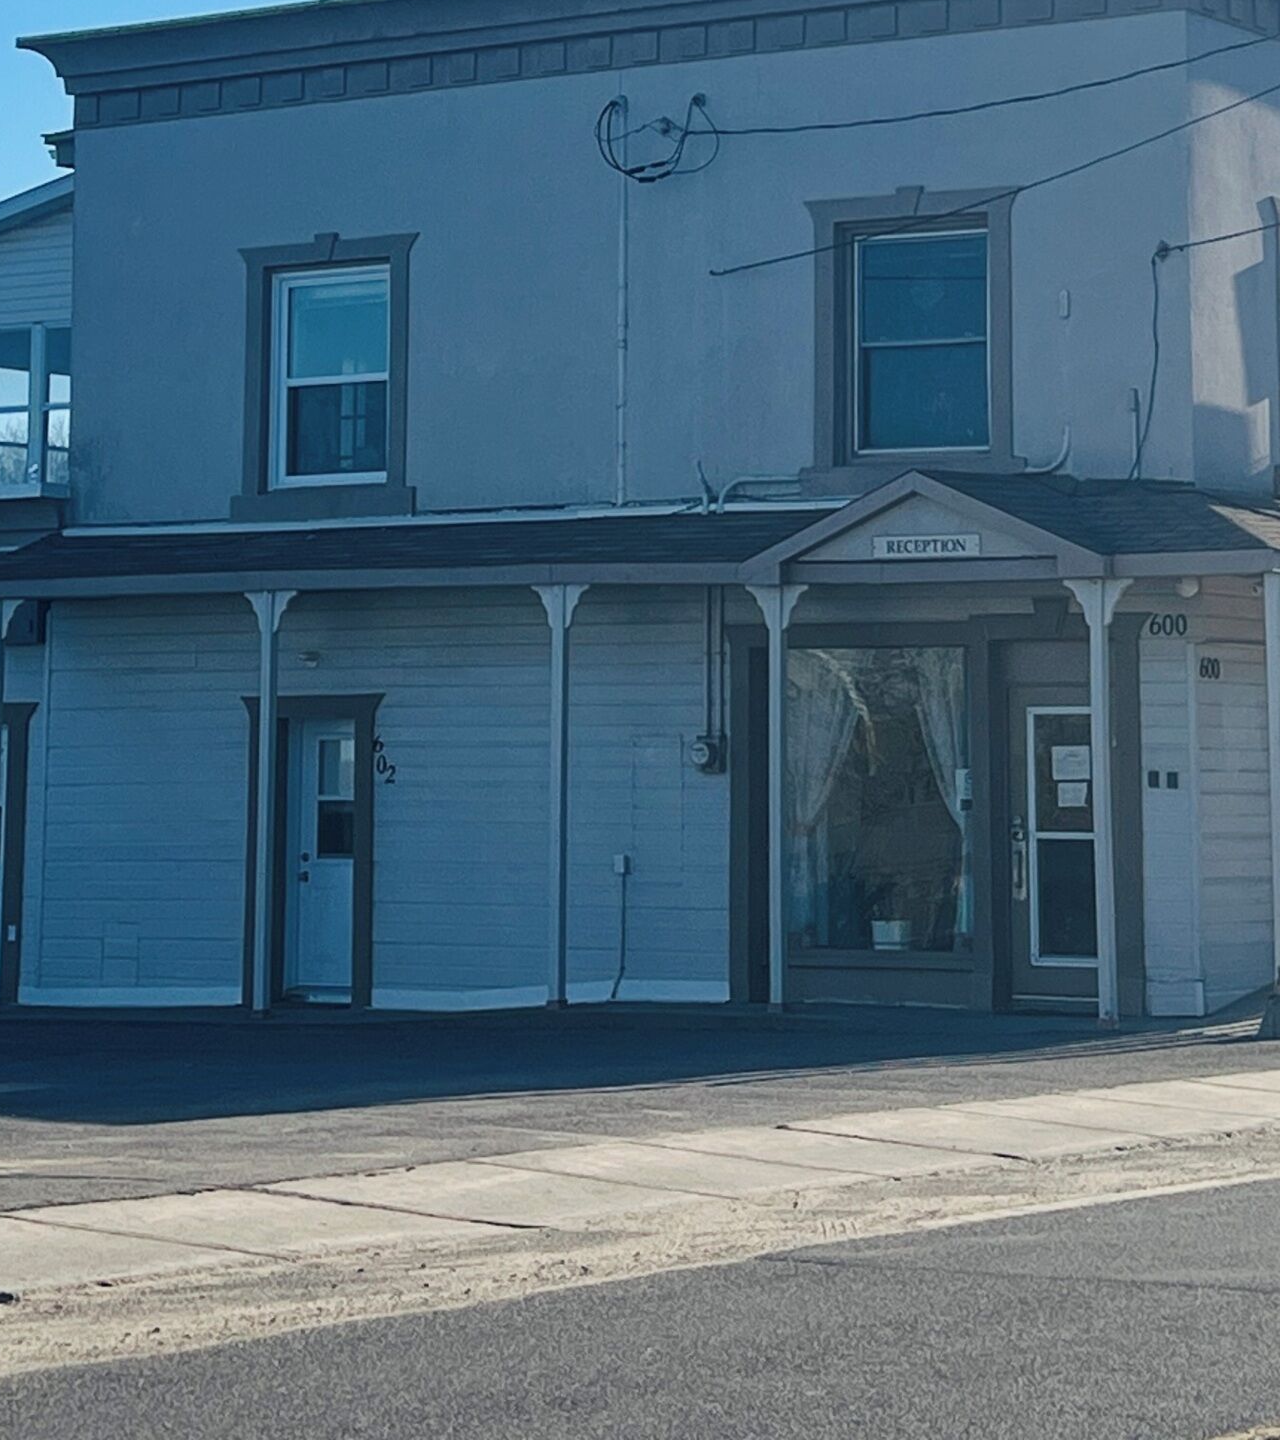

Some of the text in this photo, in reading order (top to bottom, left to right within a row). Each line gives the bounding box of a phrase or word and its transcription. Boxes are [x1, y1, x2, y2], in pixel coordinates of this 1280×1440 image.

[886, 538, 966, 555] RECEPTION
[1149, 614, 1187, 636] 600
[1199, 657, 1221, 679] 600
